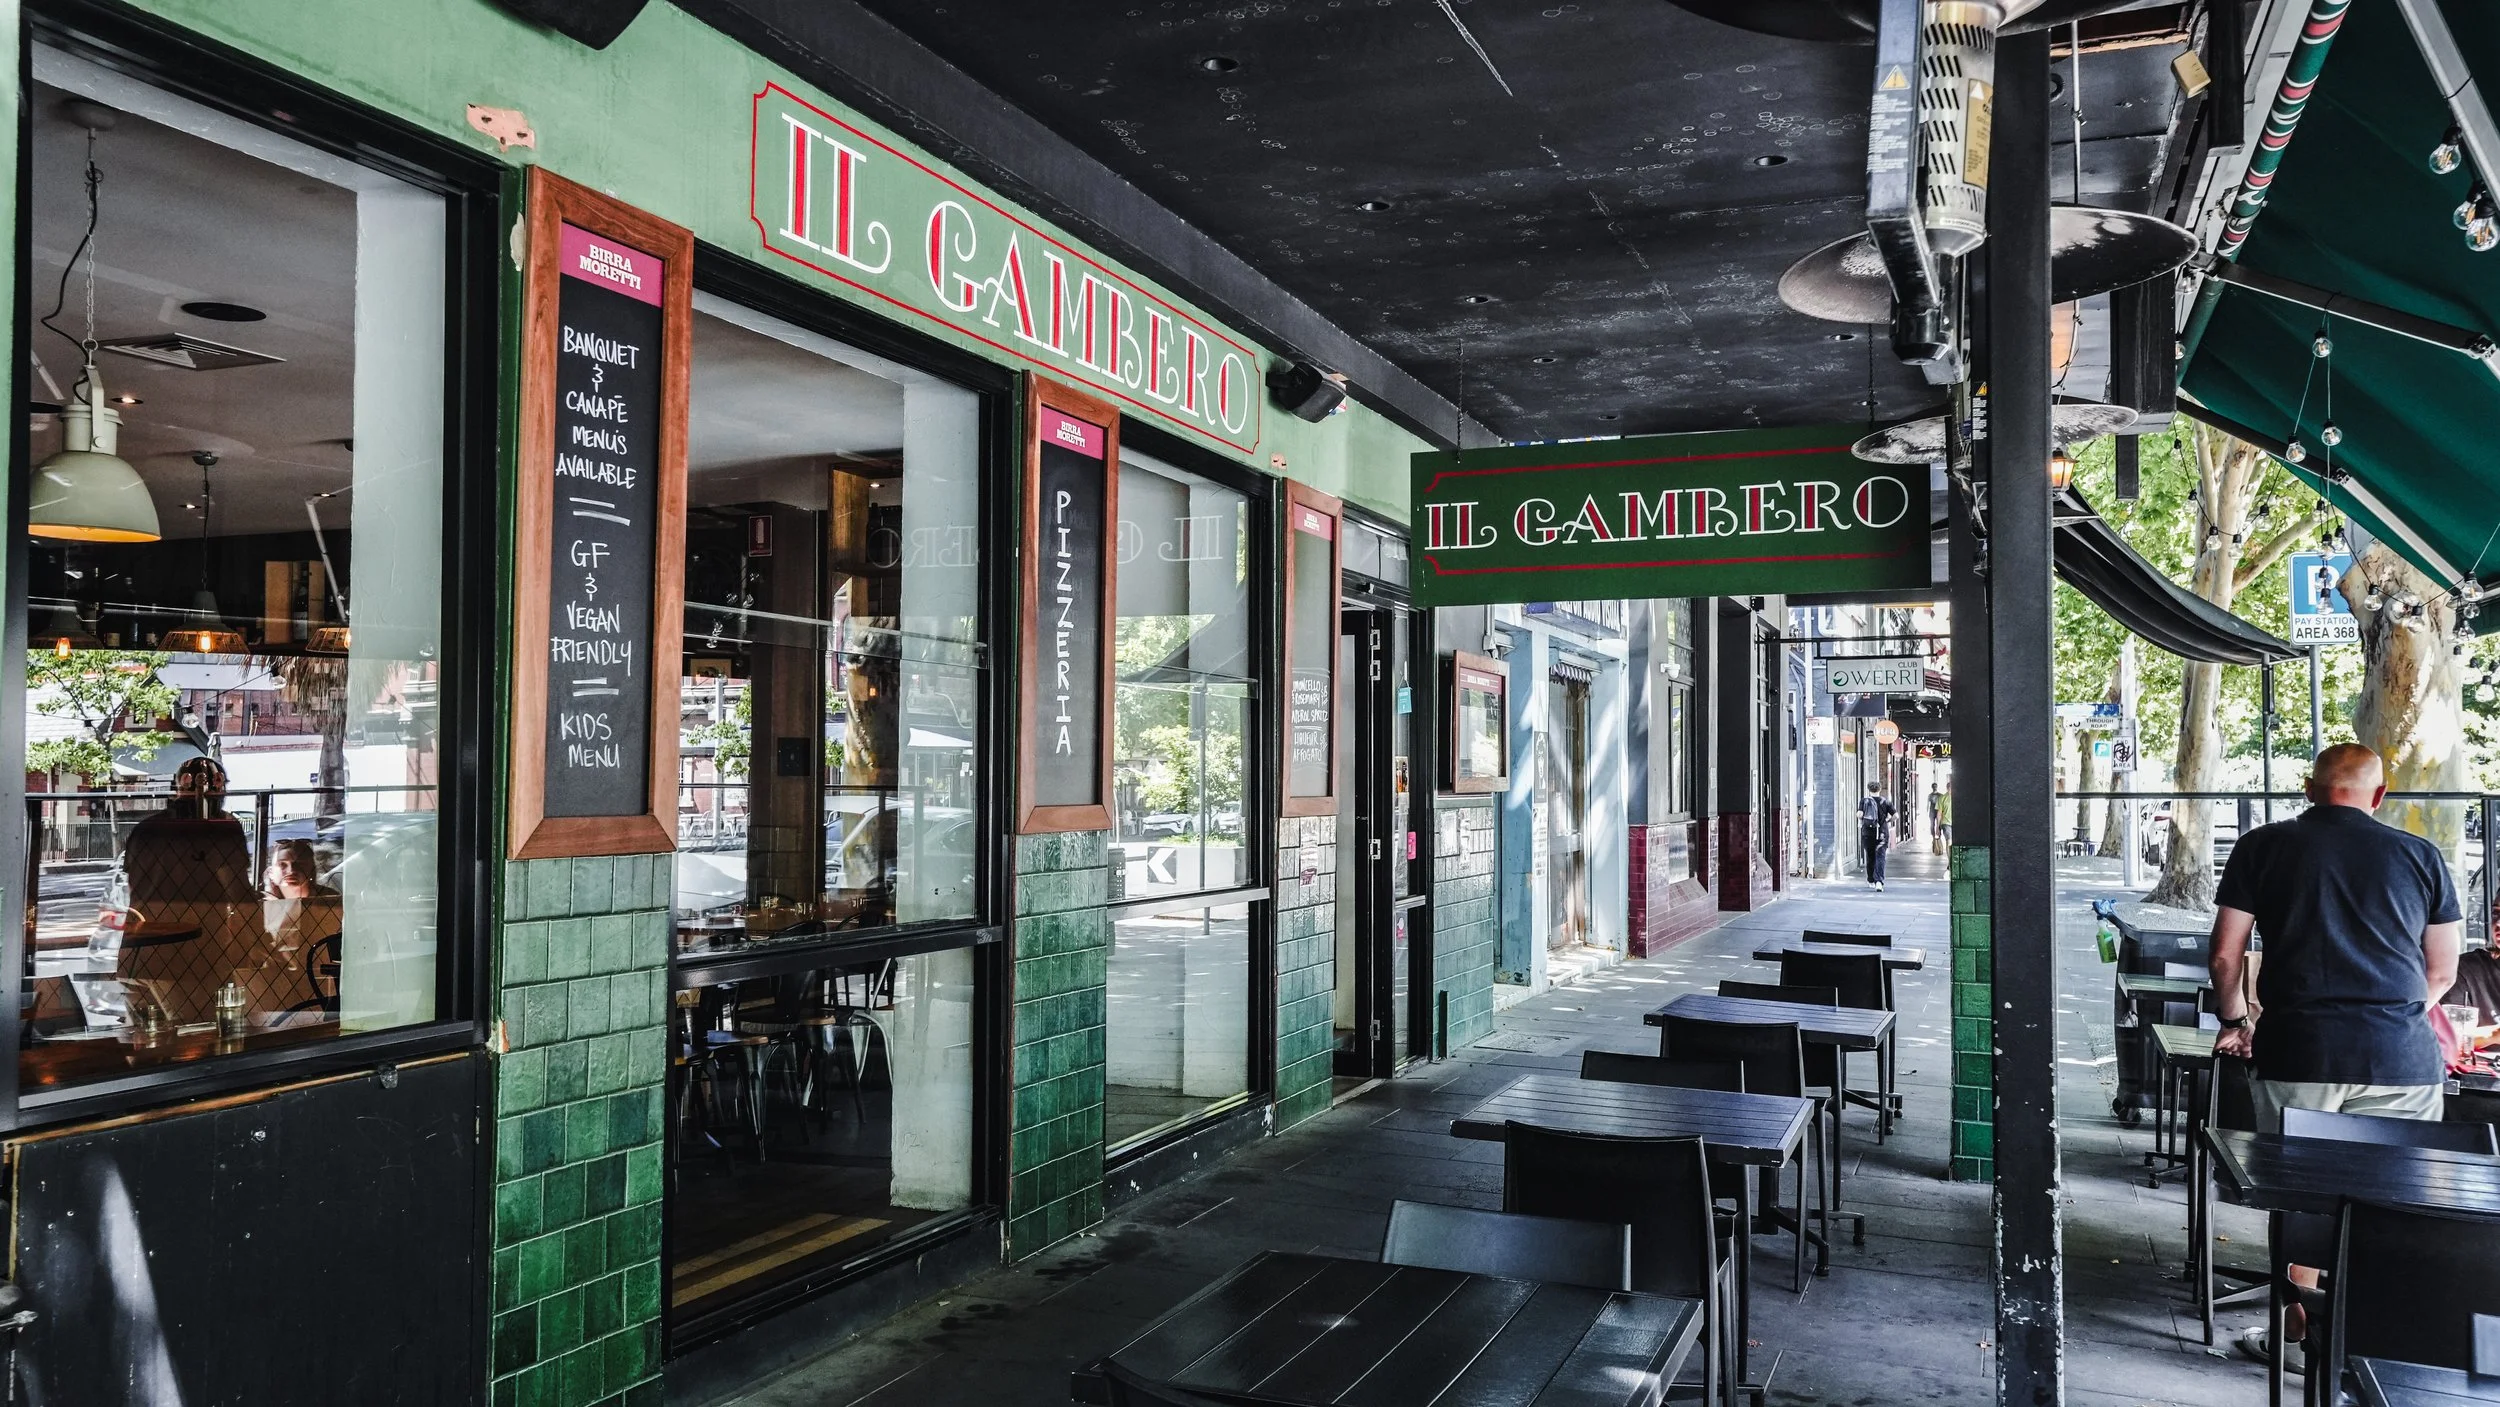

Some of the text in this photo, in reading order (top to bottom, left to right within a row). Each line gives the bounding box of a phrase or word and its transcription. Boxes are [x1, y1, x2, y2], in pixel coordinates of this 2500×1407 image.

[579, 255, 641, 290] MORETTI
[589, 244, 633, 273] BIRRA
[779, 112, 1249, 435] IL GAMBERO
[563, 325, 640, 370] BANQUET
[1056, 428, 1086, 449] MORETTI
[1060, 420, 1082, 438] BIRRA
[555, 452, 637, 489] AVAILABLE
[1424, 476, 1909, 550] IL GAMBERO
[570, 539, 610, 568] GF
[566, 601, 620, 634] VEGAN
[1055, 490, 1074, 756] PIZZERIA
[2316, 617, 2356, 625] STATION
[2296, 627, 2355, 638] AREA 368
[550, 636, 632, 677] FRIENDLY
[1898, 661, 1918, 669] CLUB
[560, 712, 612, 740] KIDS
[568, 744, 620, 769] MENU
